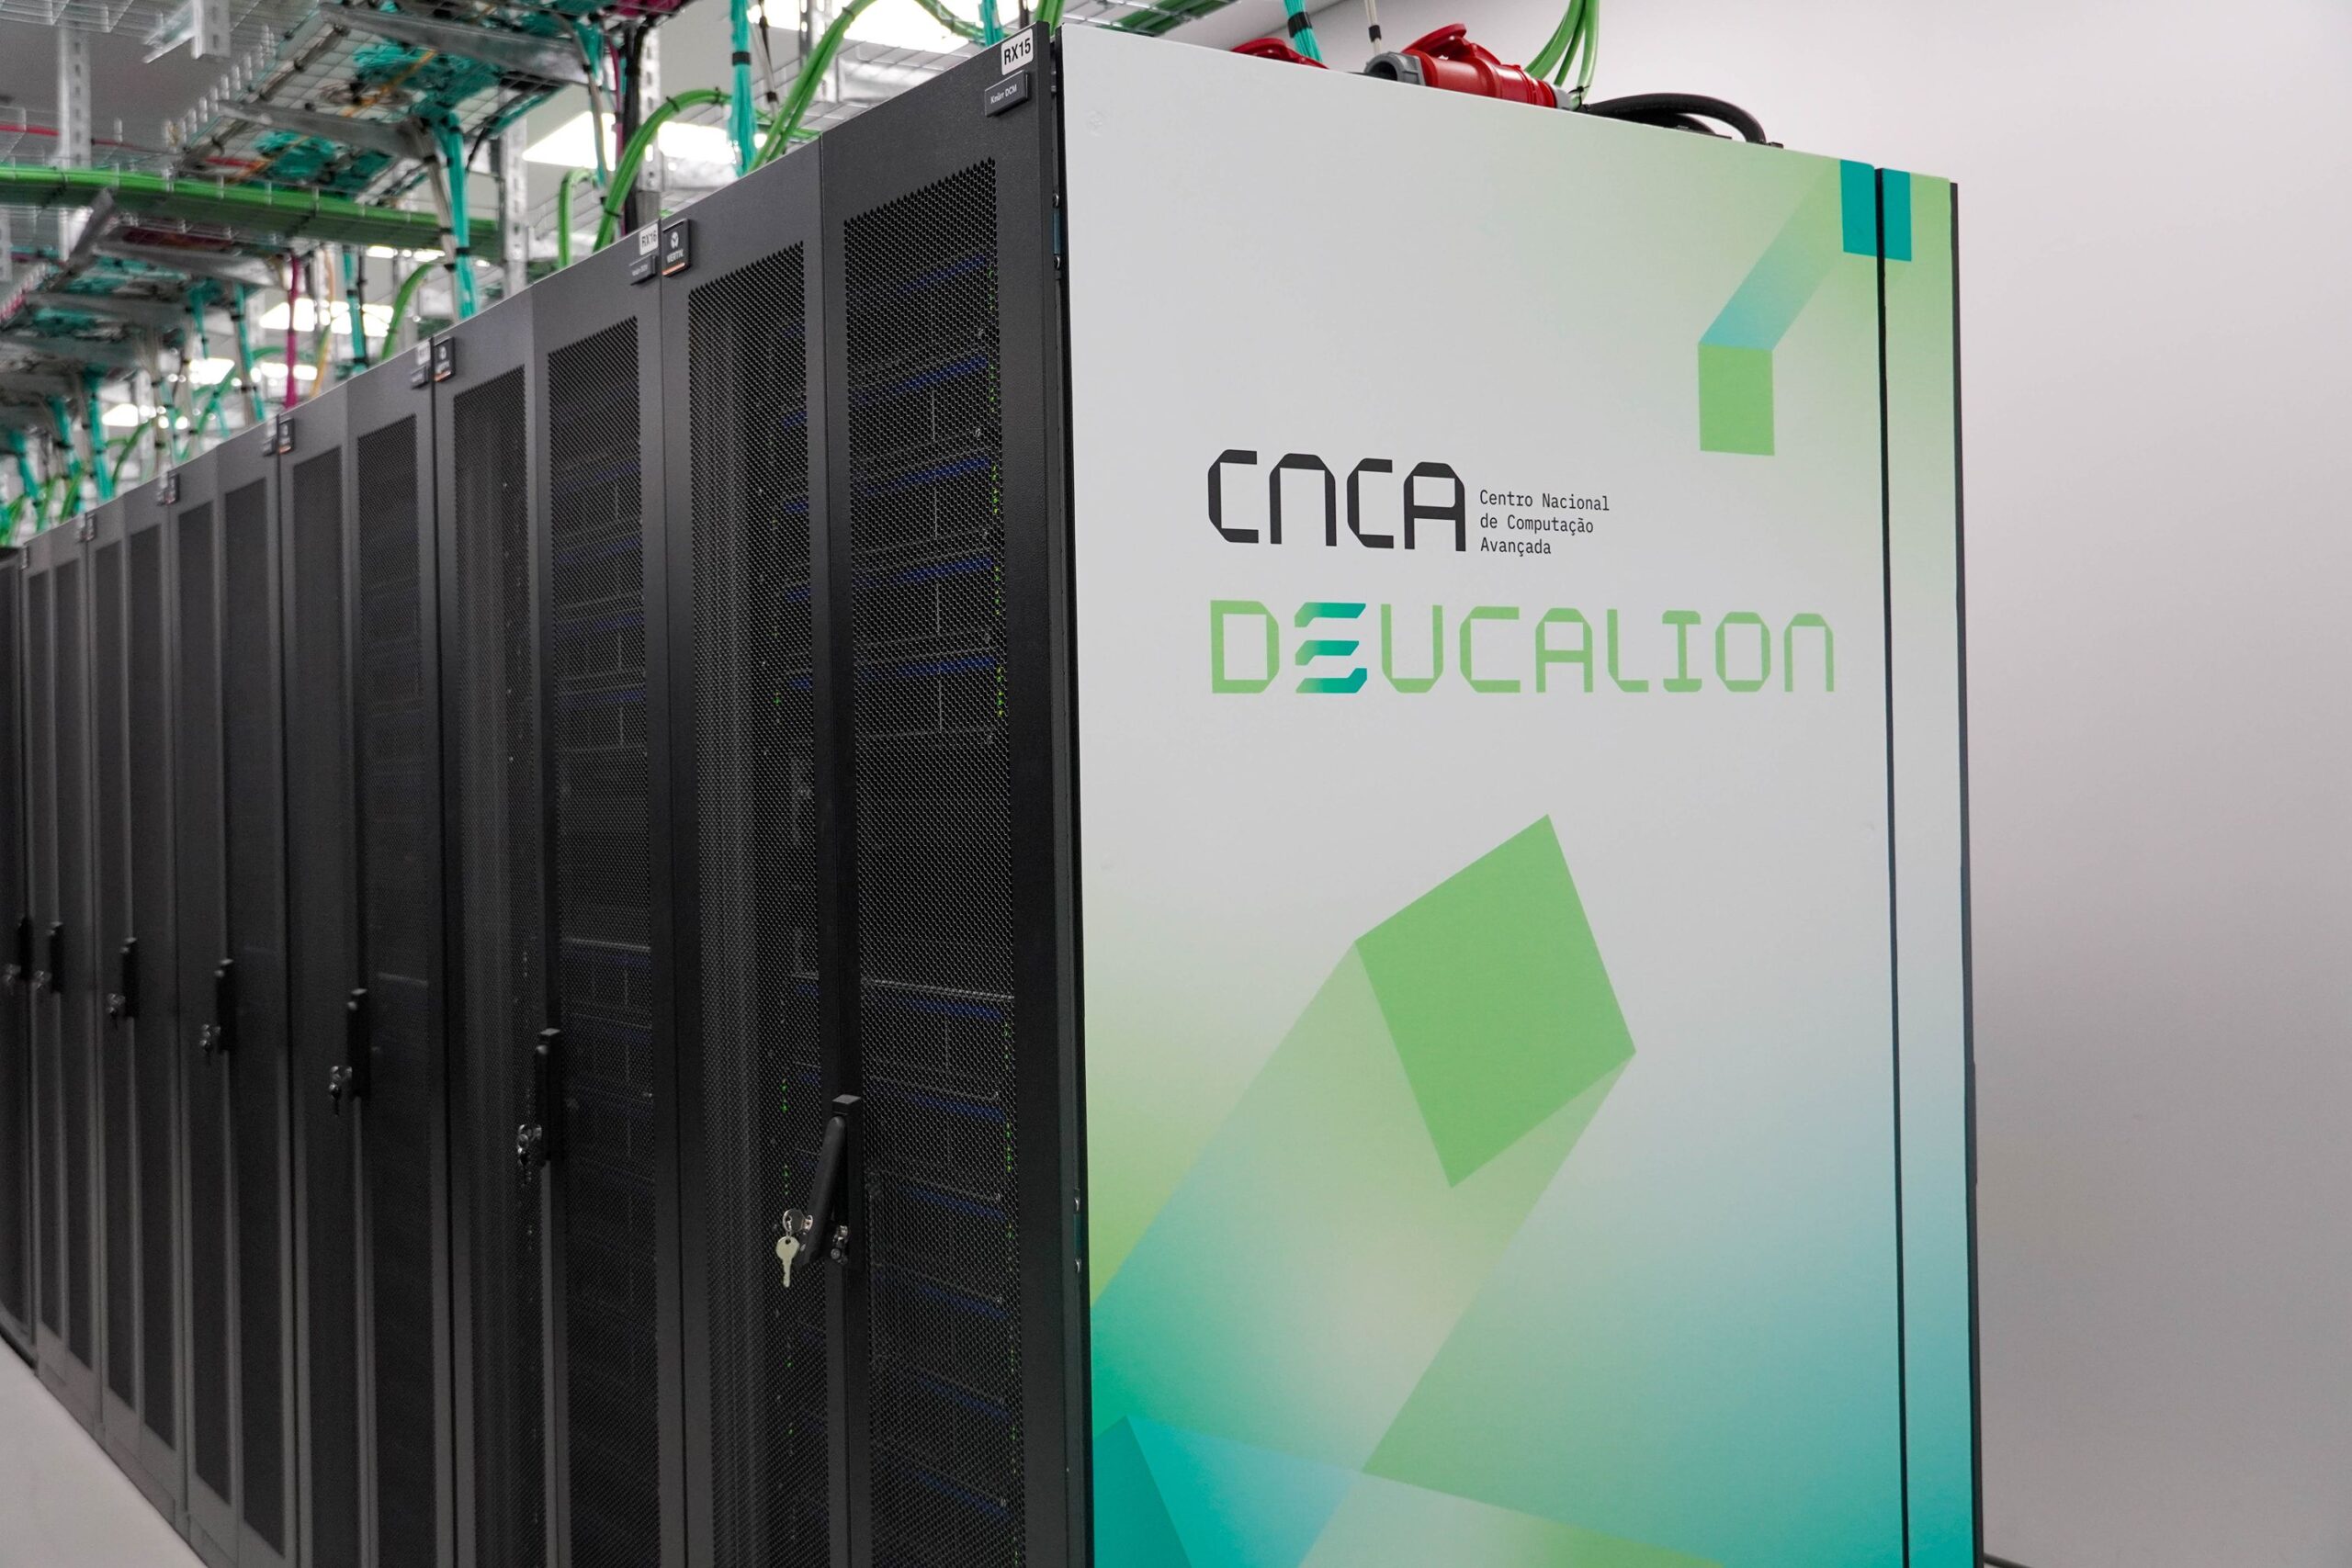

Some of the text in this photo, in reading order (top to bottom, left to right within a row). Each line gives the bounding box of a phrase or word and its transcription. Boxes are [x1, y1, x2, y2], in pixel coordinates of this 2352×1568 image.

[1004, 38, 1031, 65] RX15
[1005, 84, 1017, 96] DCM
[1207, 448, 1467, 552] CNCA
[1479, 489, 1611, 512] Centro Nacional
[1480, 513, 1594, 536] de Computação
[1480, 536, 1552, 557] Avançada
[1210, 599, 1835, 694] DEUCALION
